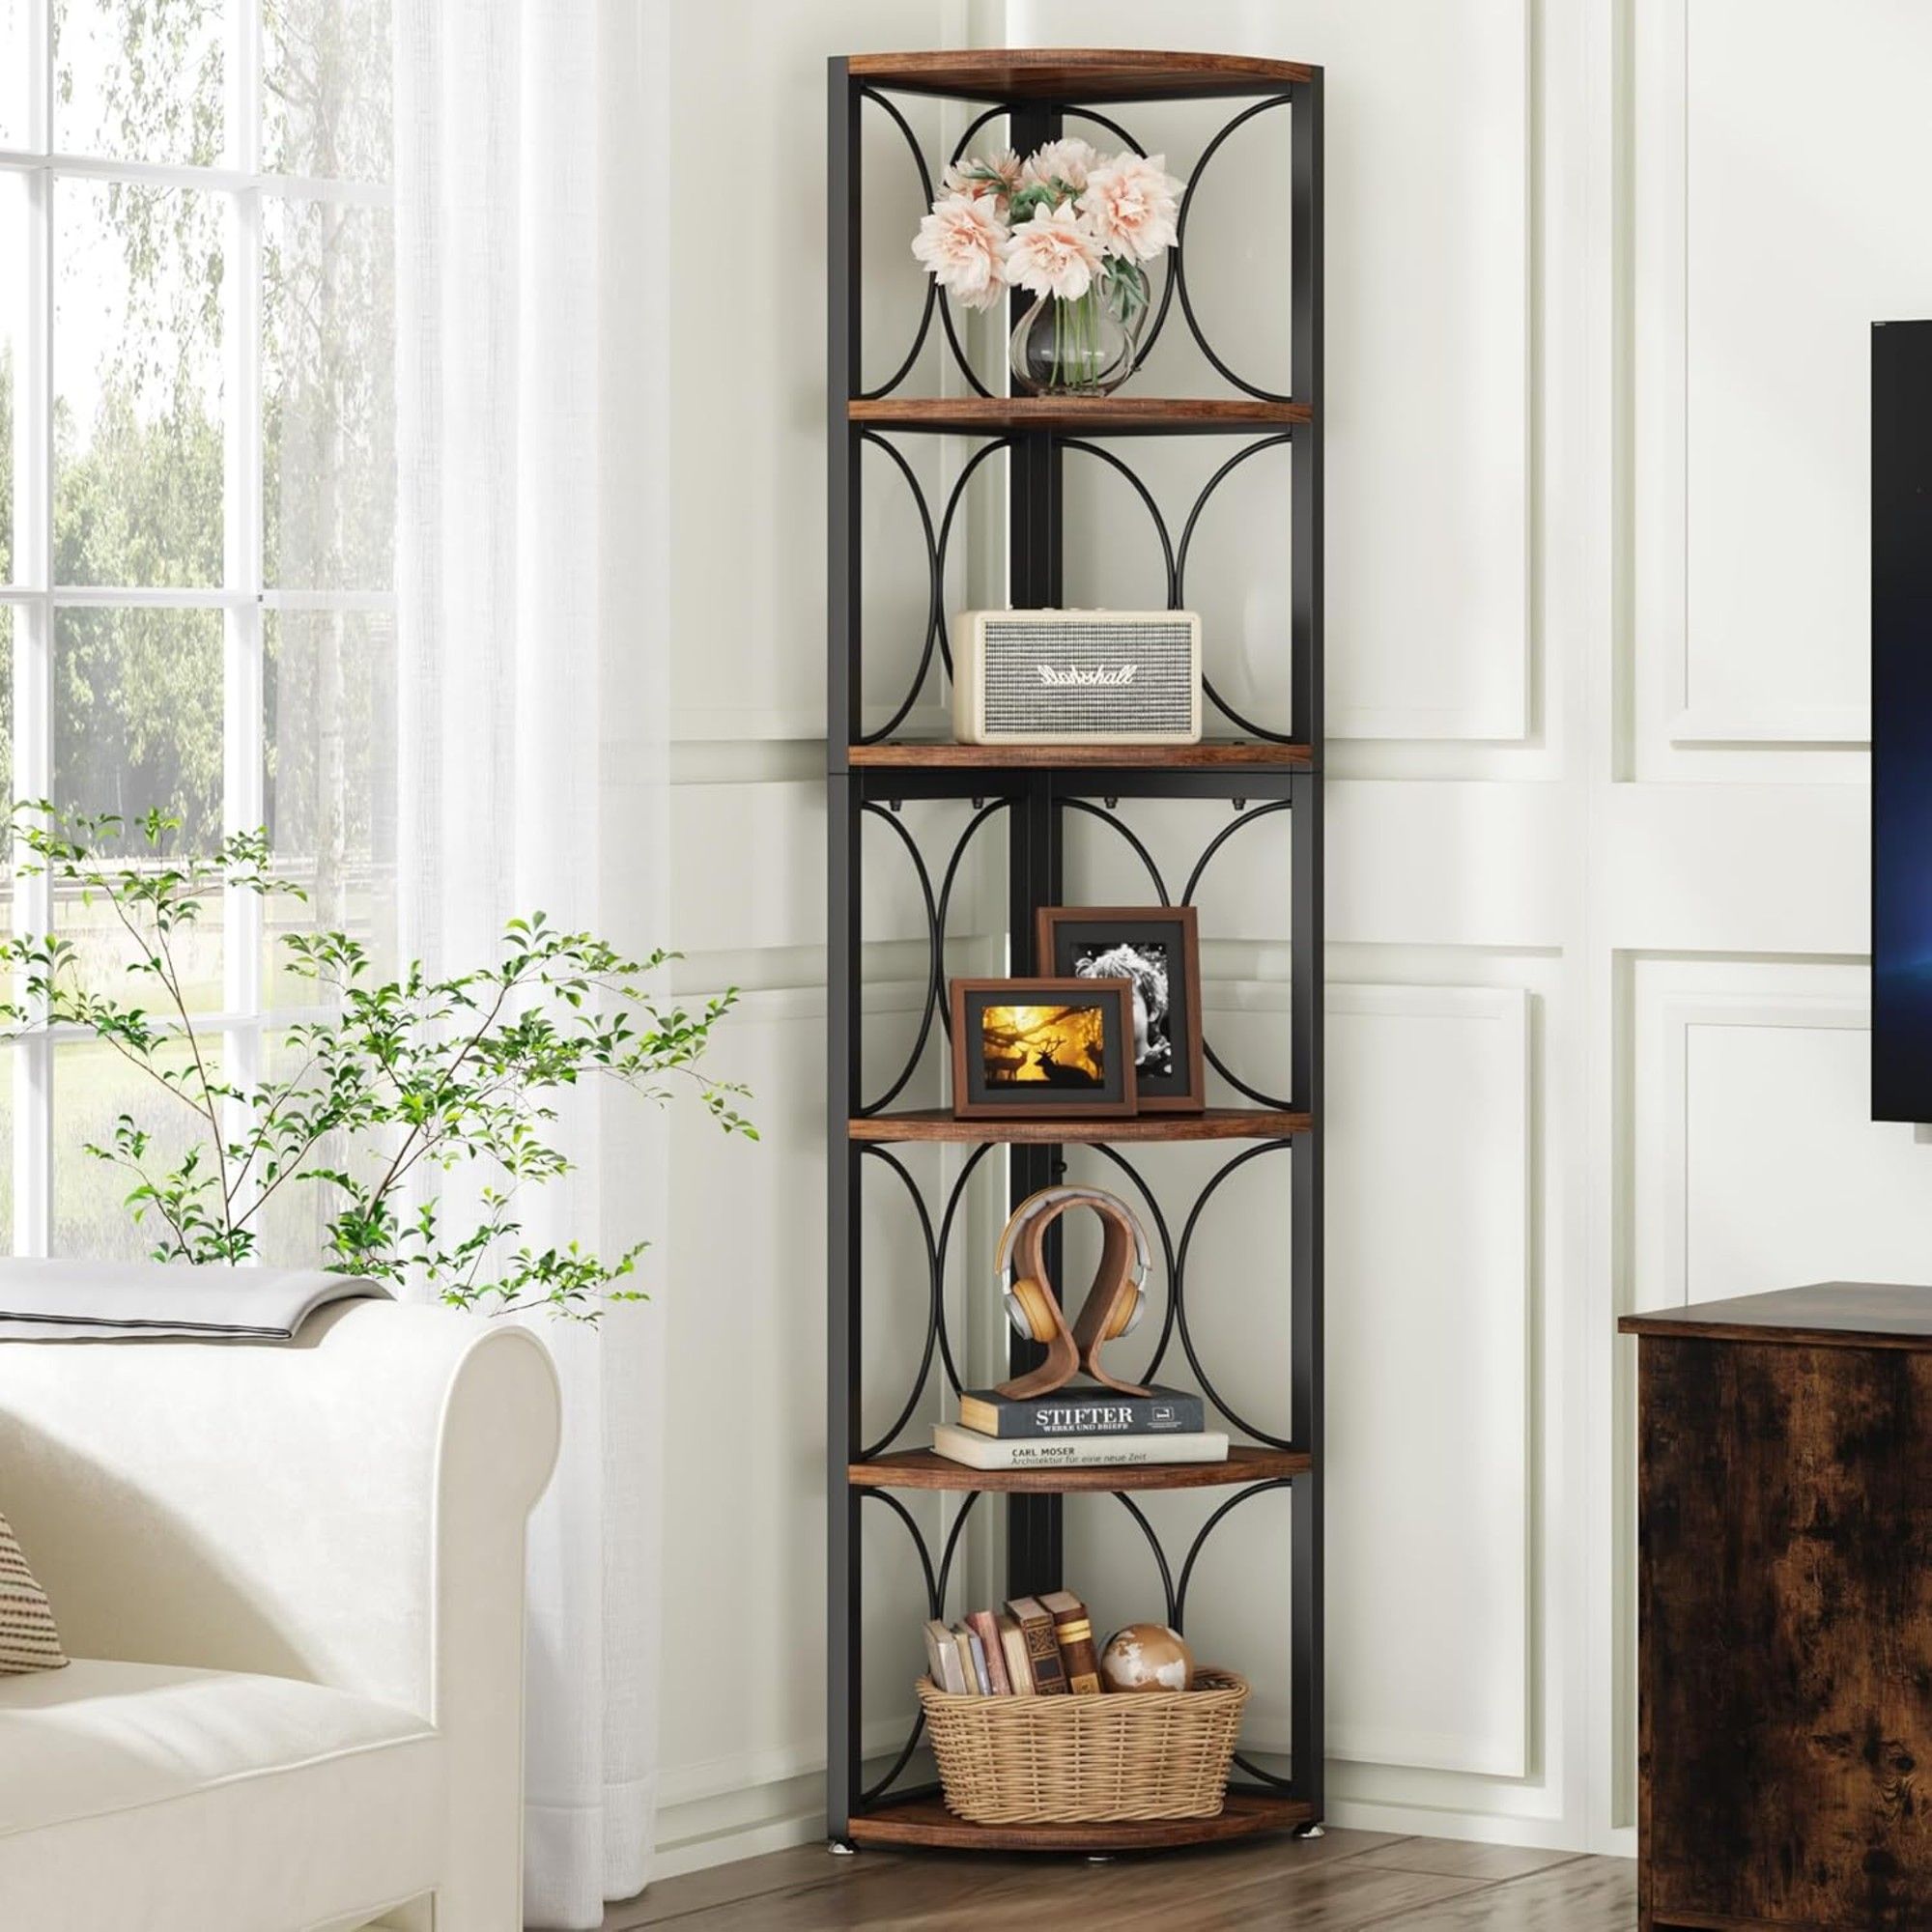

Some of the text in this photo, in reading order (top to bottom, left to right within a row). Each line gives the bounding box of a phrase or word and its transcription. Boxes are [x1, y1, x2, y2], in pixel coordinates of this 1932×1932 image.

[1037, 664, 1138, 685] Marshall
[1036, 1406, 1134, 1426] STIFTER
[1011, 1447, 1075, 1457] CARL MOSER
[1065, 1455, 1079, 1463] für
[1128, 1453, 1147, 1462] Zeit
